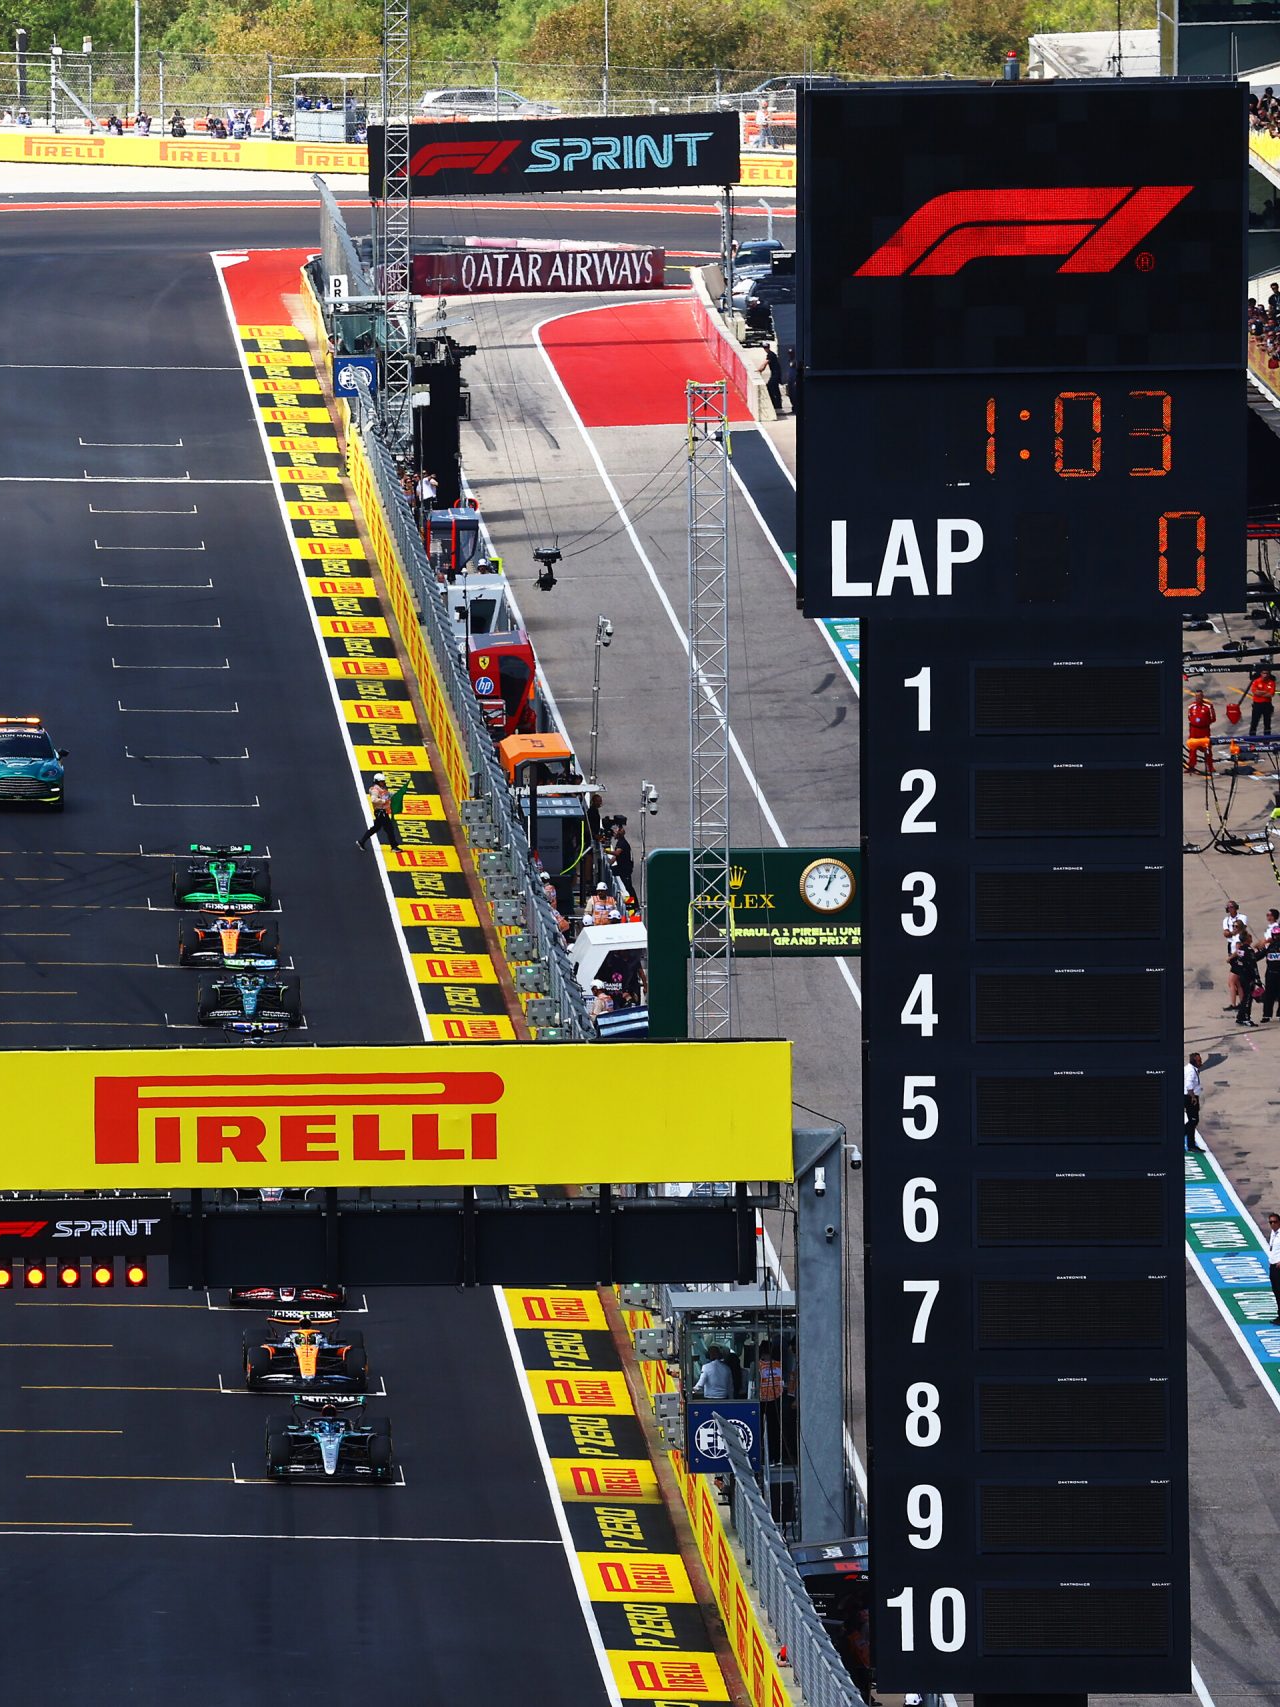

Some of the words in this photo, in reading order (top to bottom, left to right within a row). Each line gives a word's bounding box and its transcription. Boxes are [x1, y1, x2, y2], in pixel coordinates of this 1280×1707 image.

[24, 137, 105, 158] PIRELLI
[160, 142, 241, 162] PIRELLI
[296, 146, 368, 167] PIRELL
[524, 132, 713, 172] SPRINT
[461, 254, 542, 291] QATAR
[547, 252, 653, 286] AIRWAYS
[986, 391, 1173, 477] 1:03
[832, 518, 984, 596] LAP
[1159, 511, 1206, 597] 0
[905, 667, 931, 731] 1
[900, 769, 937, 833] 2
[900, 872, 938, 936] 3
[720, 928, 780, 937] FRMULA
[792, 928, 838, 936] PIRELLI
[773, 936, 818, 946] GRAND
[819, 936, 849, 945] PRIX
[900, 974, 939, 1037] 4
[94, 1071, 506, 1164] PIRELLI
[902, 1076, 939, 1140] 5
[902, 1177, 939, 1243] 6
[52, 1218, 161, 1238] SPRINT
[903, 1280, 940, 1343] 7
[546, 1379, 616, 1407] PIRELLI
[568, 1416, 615, 1447] ZERO
[905, 1382, 942, 1447] 8
[579, 1447, 619, 1457] P
[570, 1467, 643, 1497] PIRELLI
[594, 1507, 645, 1540] ZERO
[906, 1485, 943, 1549] 9
[605, 1540, 648, 1550] P
[597, 1562, 675, 1593] PIRELLI
[623, 1604, 676, 1638] ZERO
[887, 1587, 966, 1652] 10
[635, 1638, 680, 1648] P
[628, 1661, 709, 1692] PIRELLI
